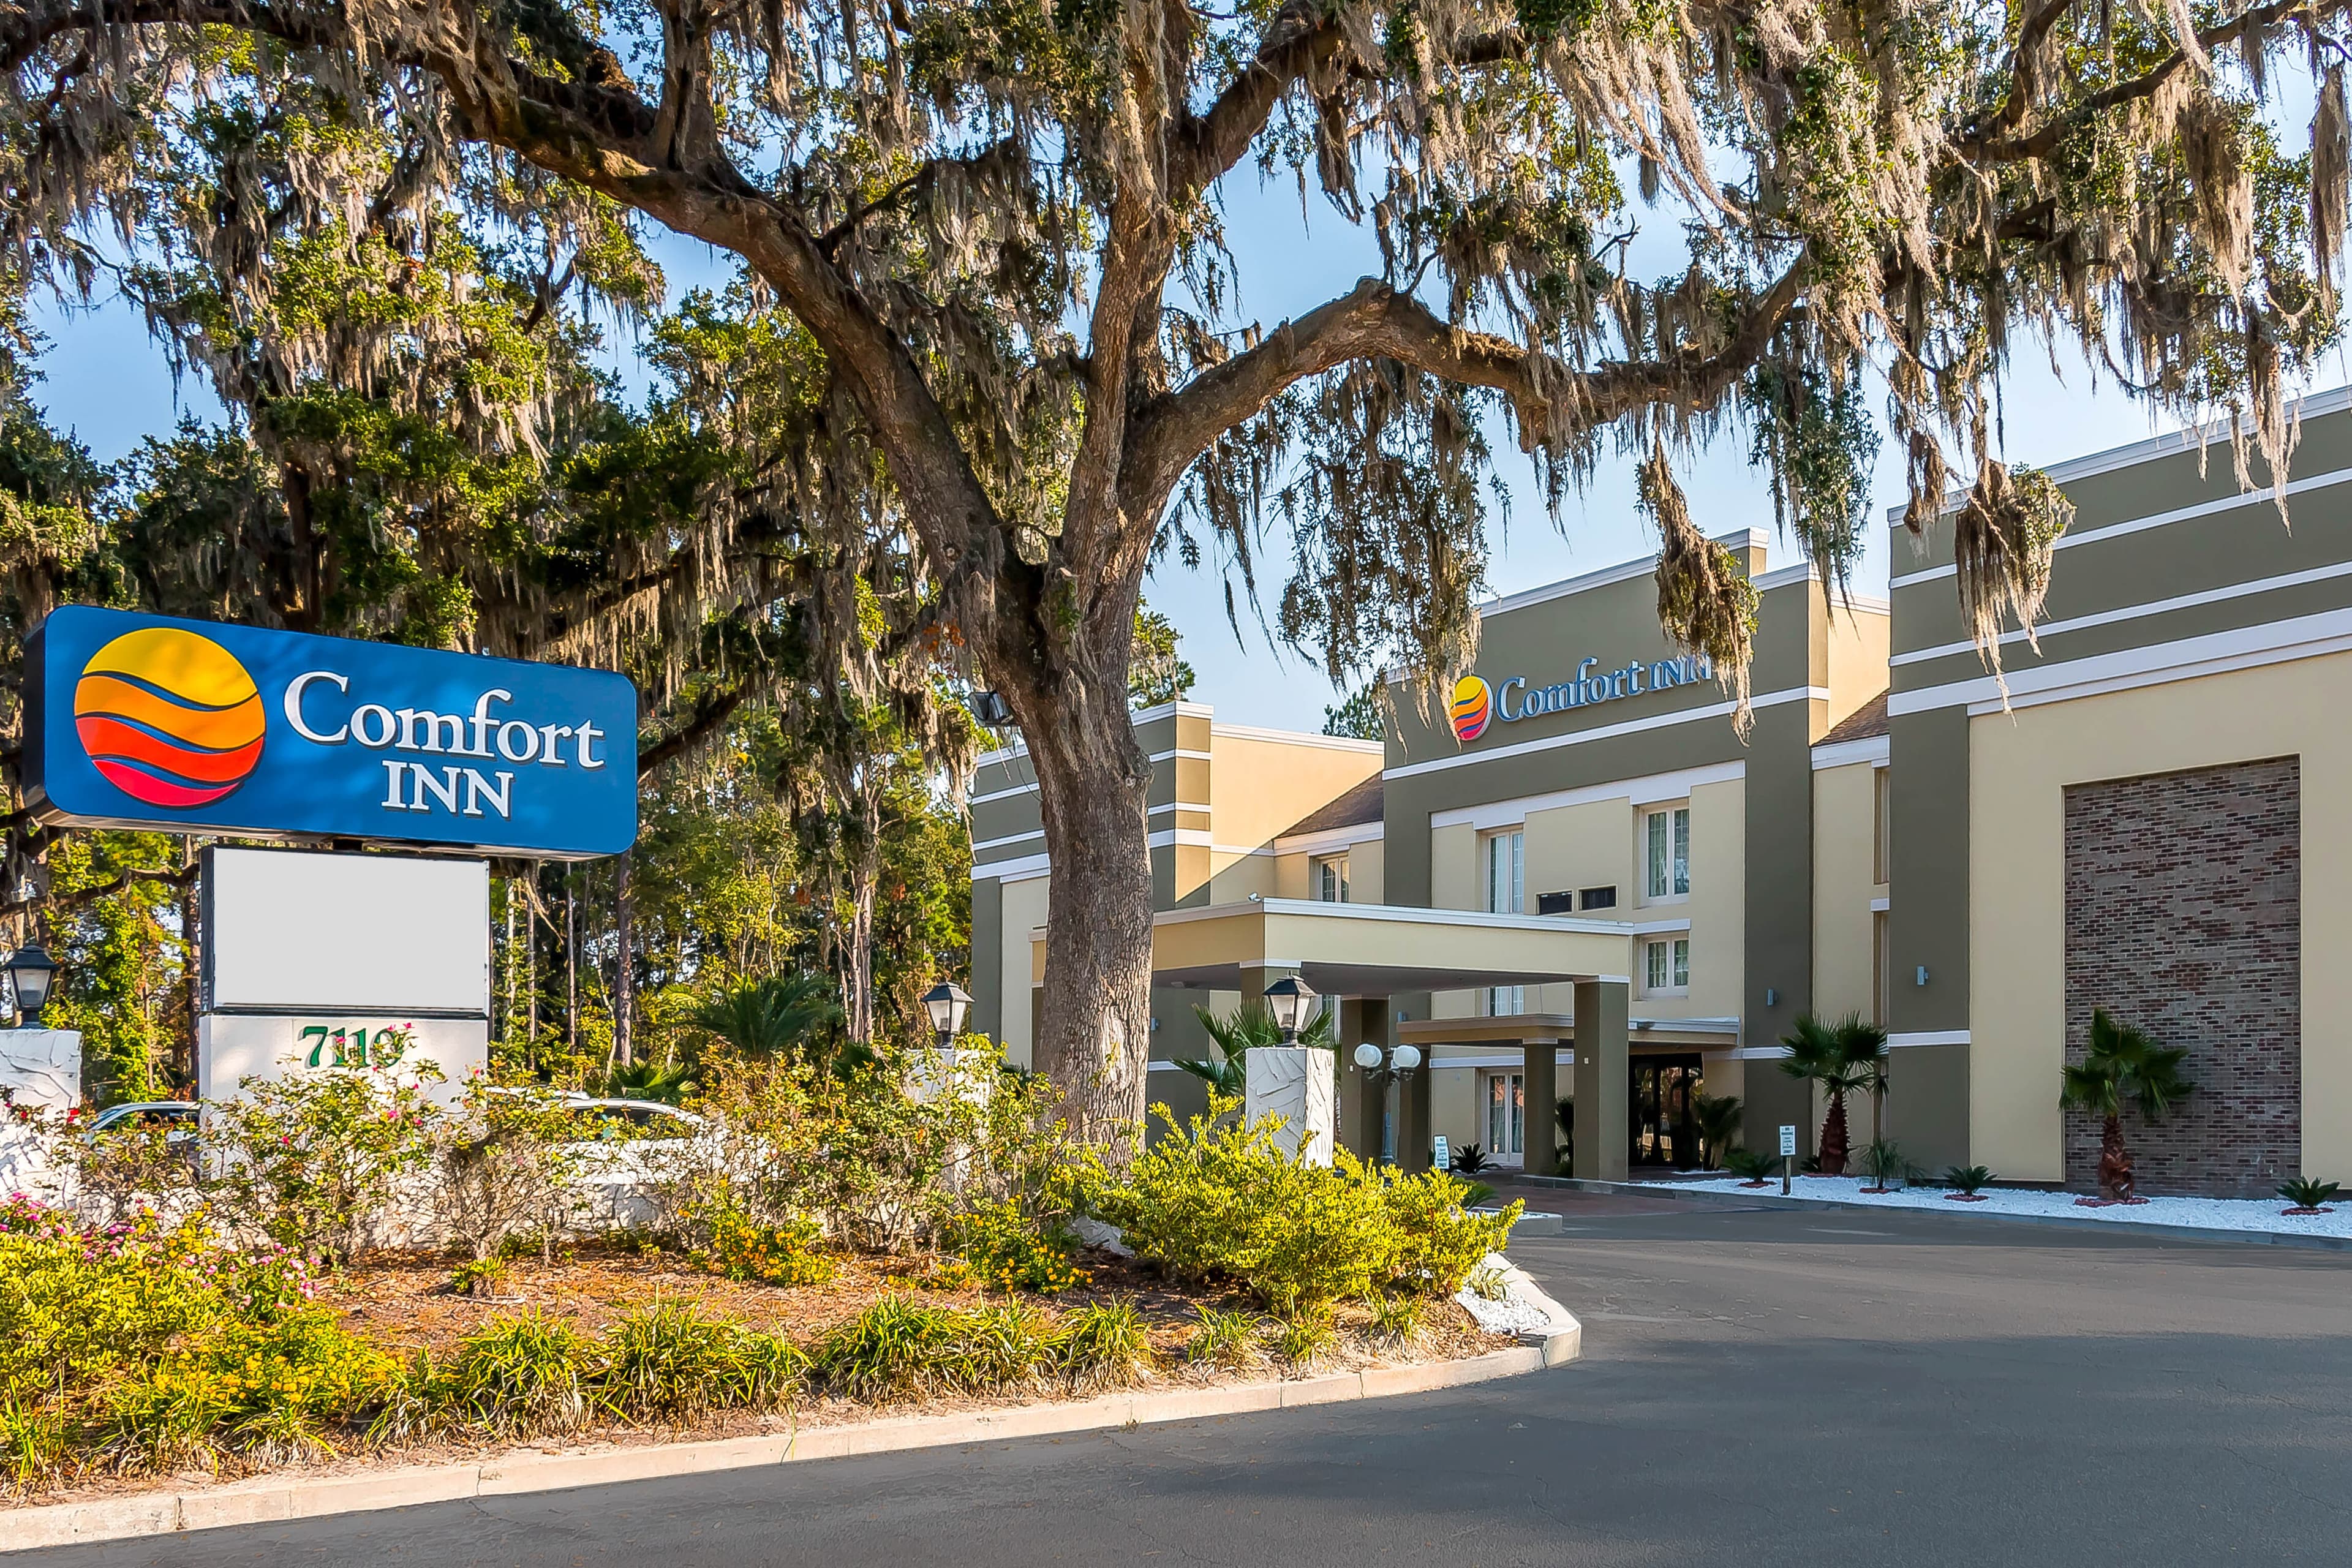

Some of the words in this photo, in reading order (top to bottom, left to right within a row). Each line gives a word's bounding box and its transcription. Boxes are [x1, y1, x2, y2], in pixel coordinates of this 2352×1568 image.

[284, 671, 606, 768] Comfort
[1496, 657, 1645, 722] Comfort
[1647, 652, 1713, 691] INN
[381, 760, 514, 818] INN
